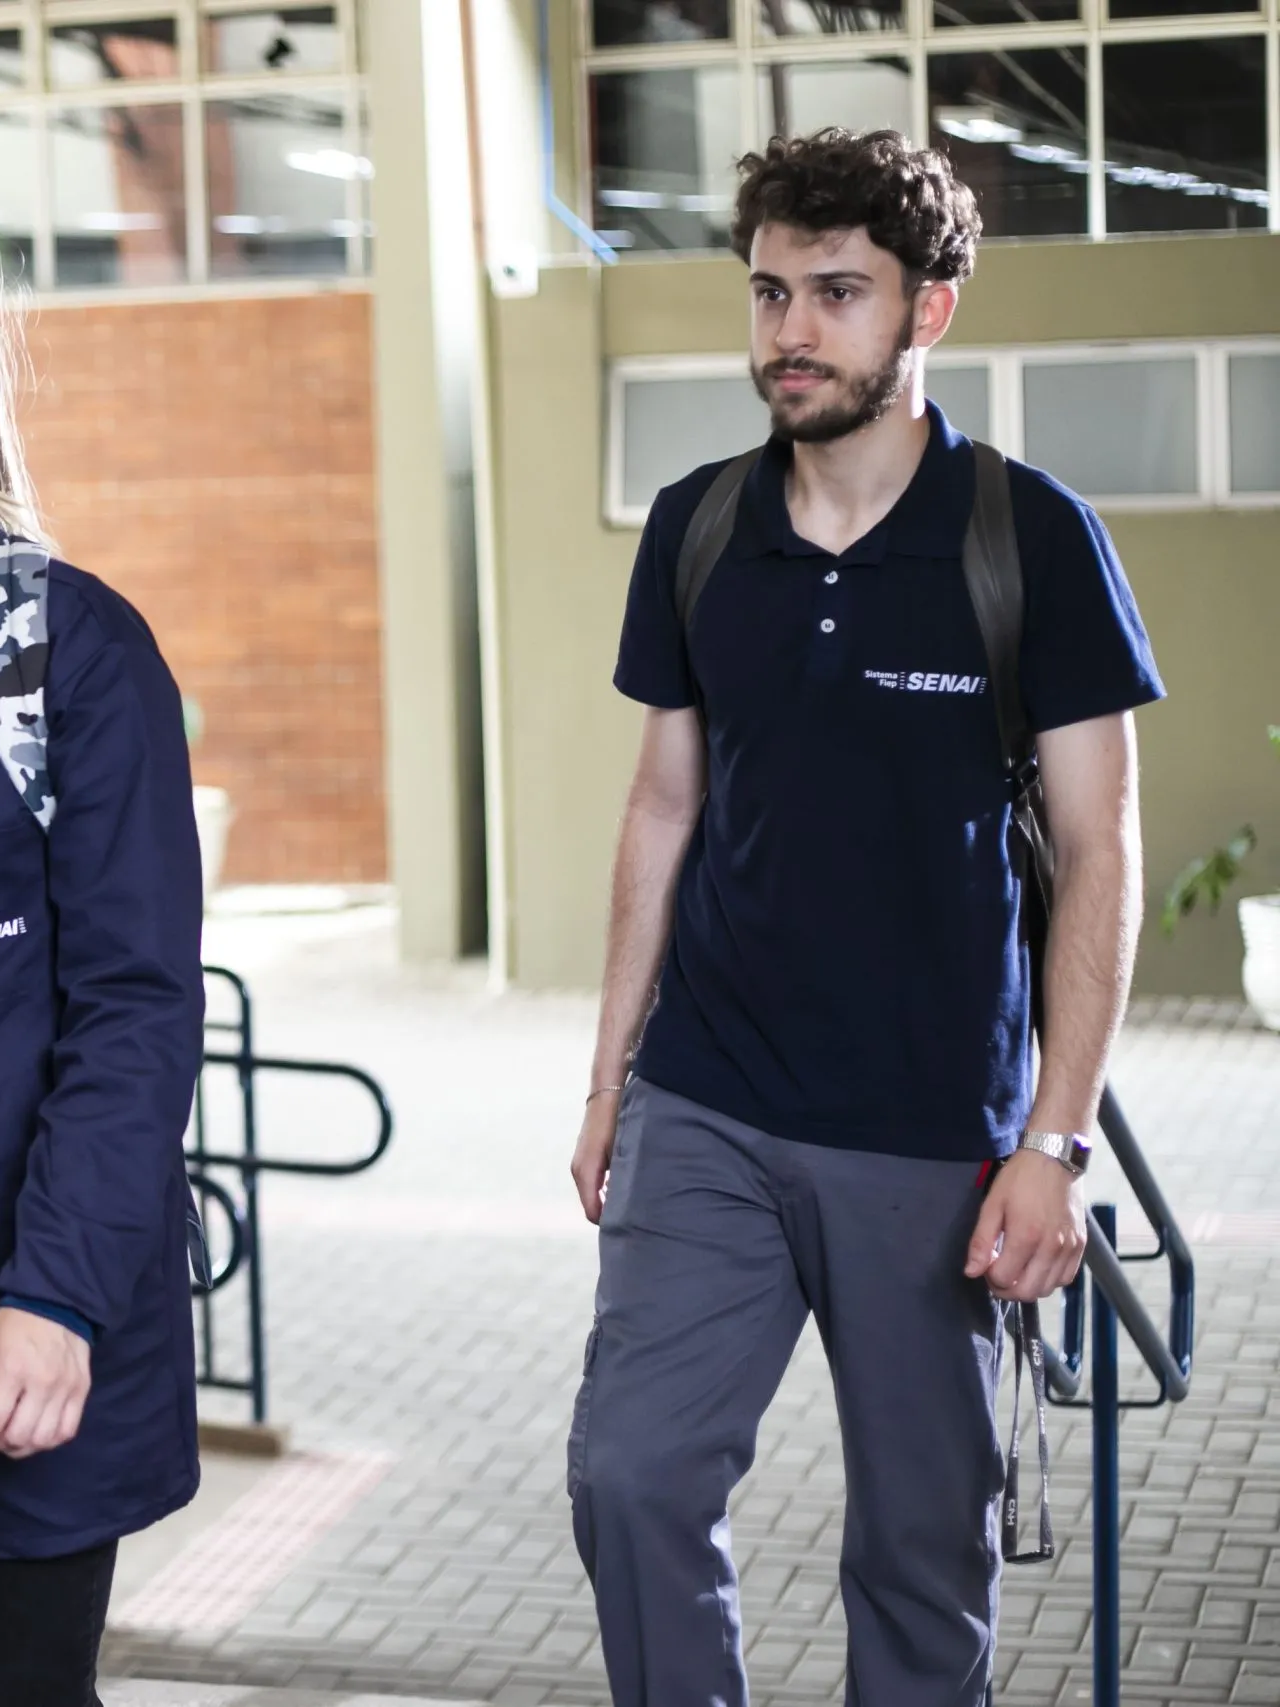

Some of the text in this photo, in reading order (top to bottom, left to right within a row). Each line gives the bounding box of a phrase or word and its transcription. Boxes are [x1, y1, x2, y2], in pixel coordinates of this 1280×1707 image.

[864, 669, 898, 679] Sistema
[879, 679, 898, 689] Fiep
[907, 672, 980, 693] SENAI
[1030, 1339, 1041, 1366] CNH
[1007, 1499, 1016, 1526] CNH
